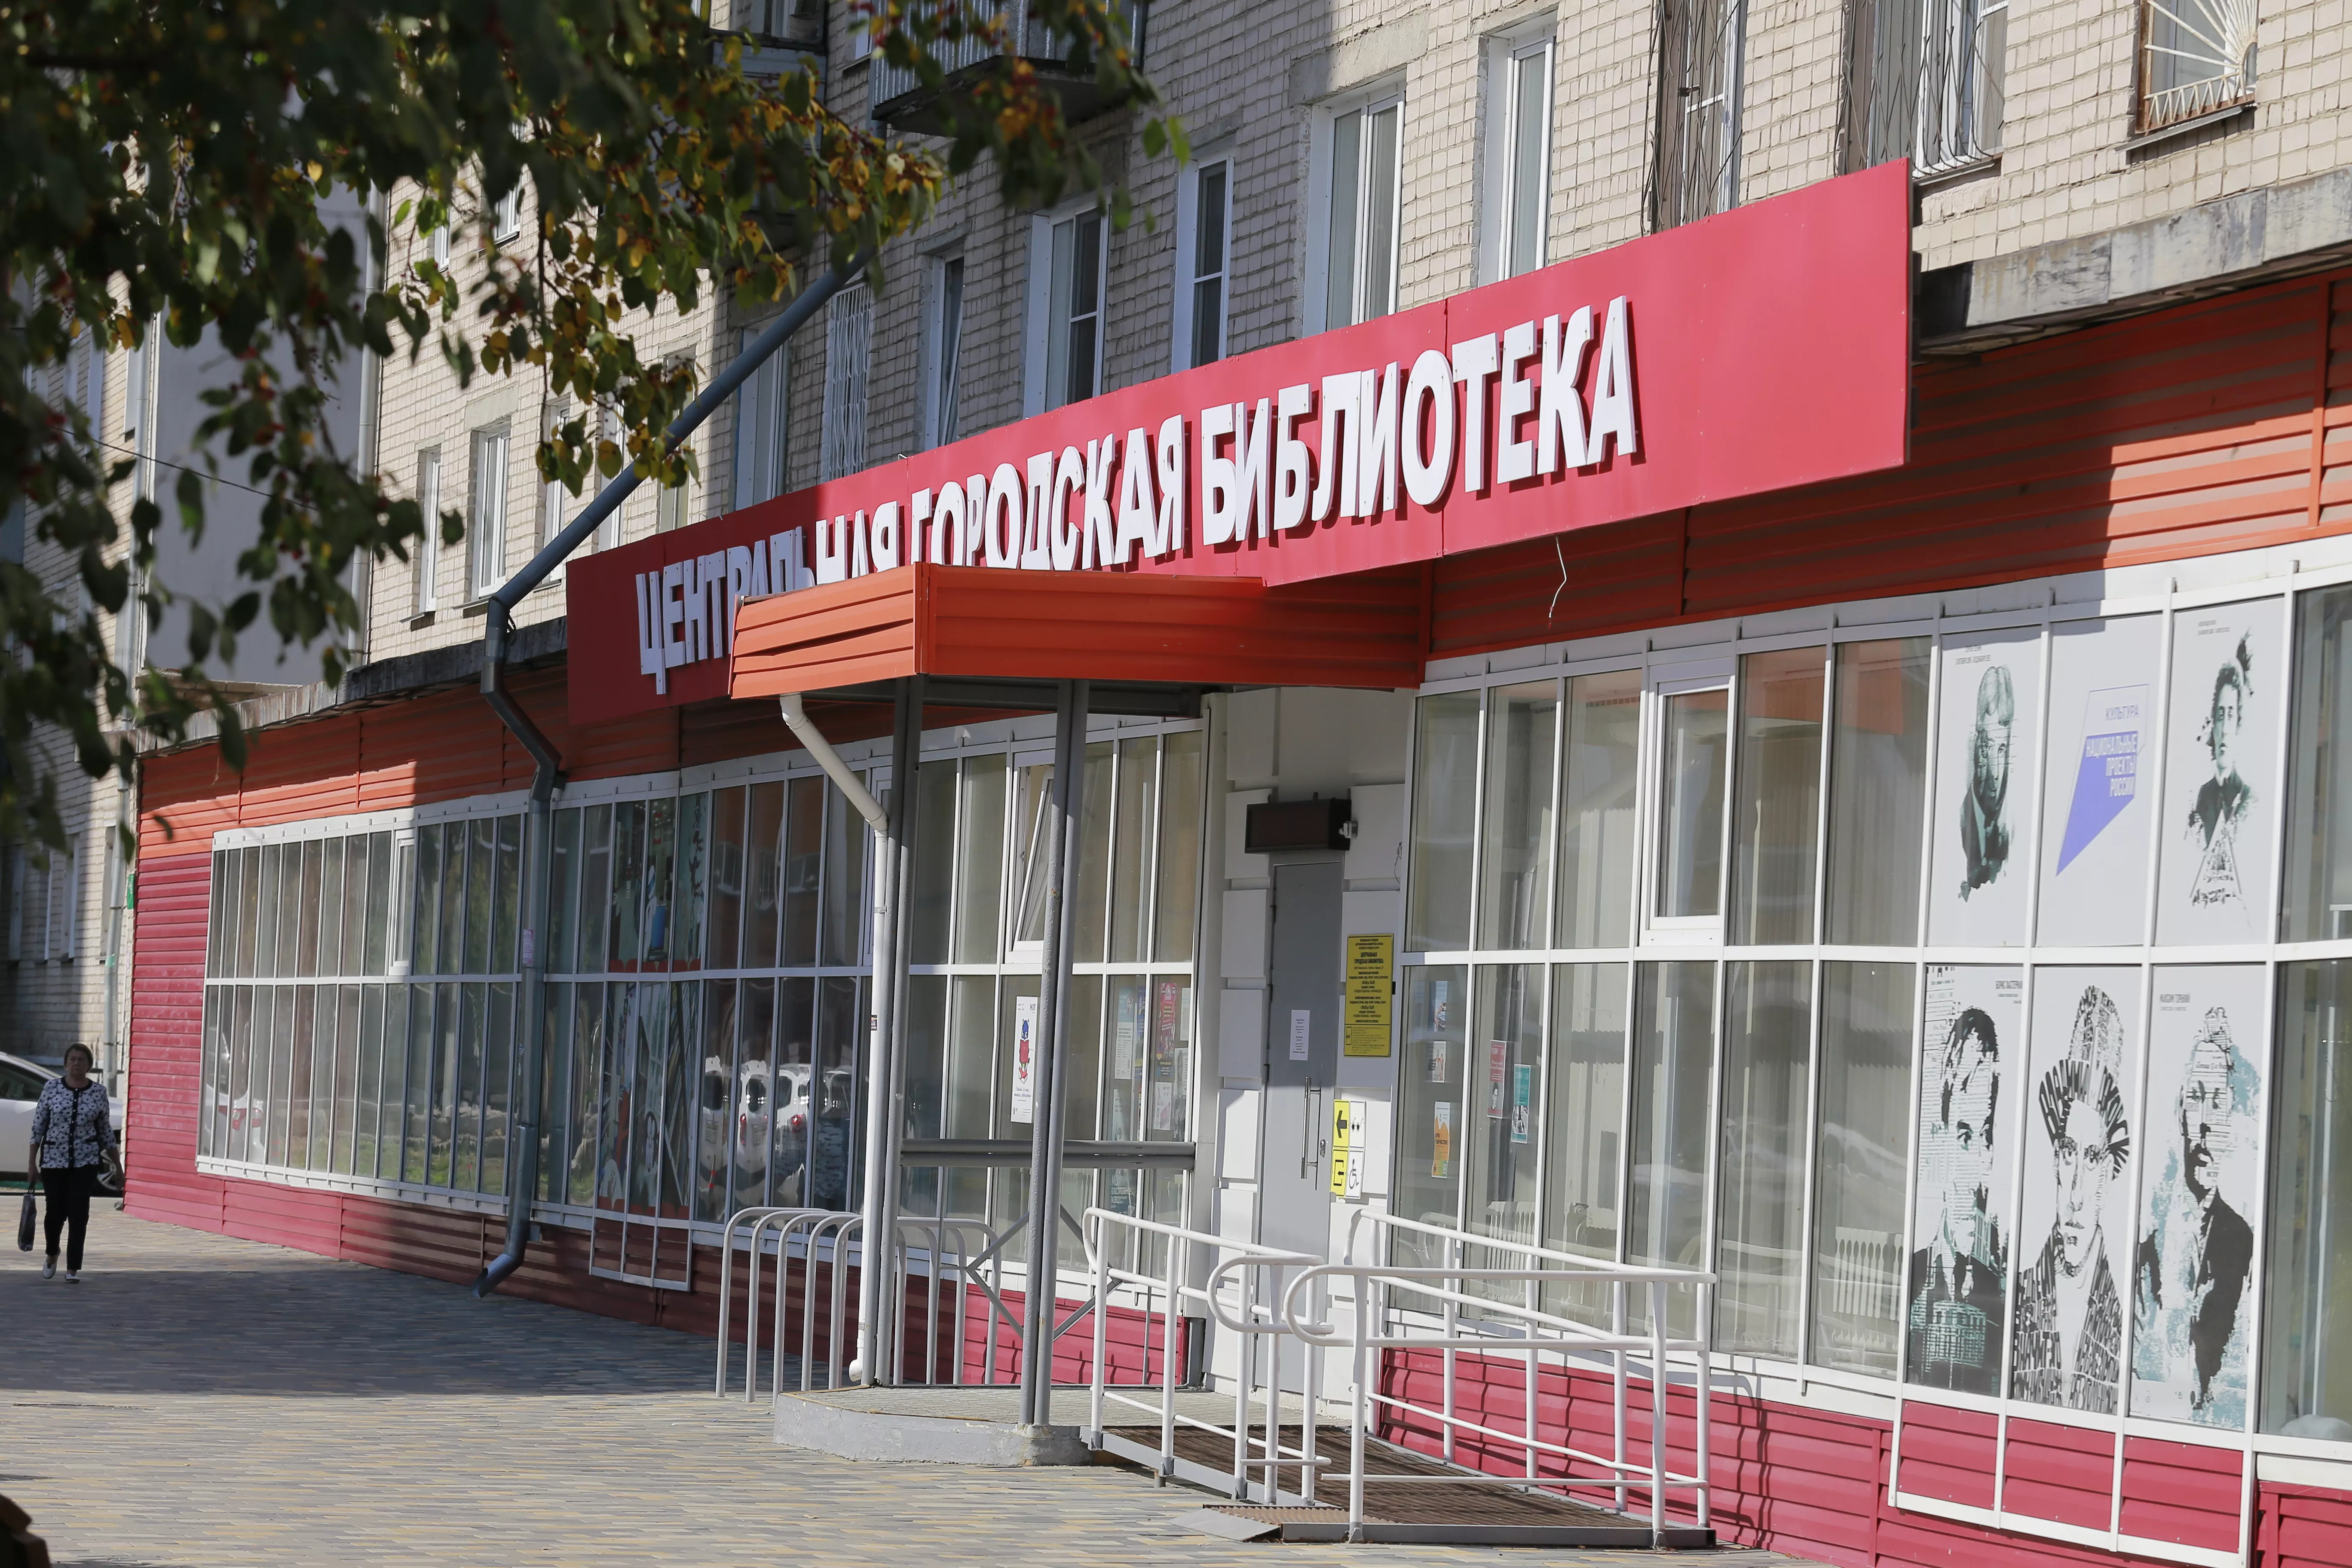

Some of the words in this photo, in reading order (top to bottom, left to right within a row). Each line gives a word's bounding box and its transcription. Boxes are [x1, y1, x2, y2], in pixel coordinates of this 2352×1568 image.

[911, 413, 1185, 572] ГОРОДСКАЯ
[1200, 295, 1637, 546] БИБЛИОТЕКА
[2105, 704, 2139, 721] КУЛЬТУРА
[2086, 734, 2137, 758] НАЦИОНАЛЬНЫЕ
[2106, 755, 2137, 776] ПРОЕКТЫ
[2109, 776, 2135, 797] РОССИИ
